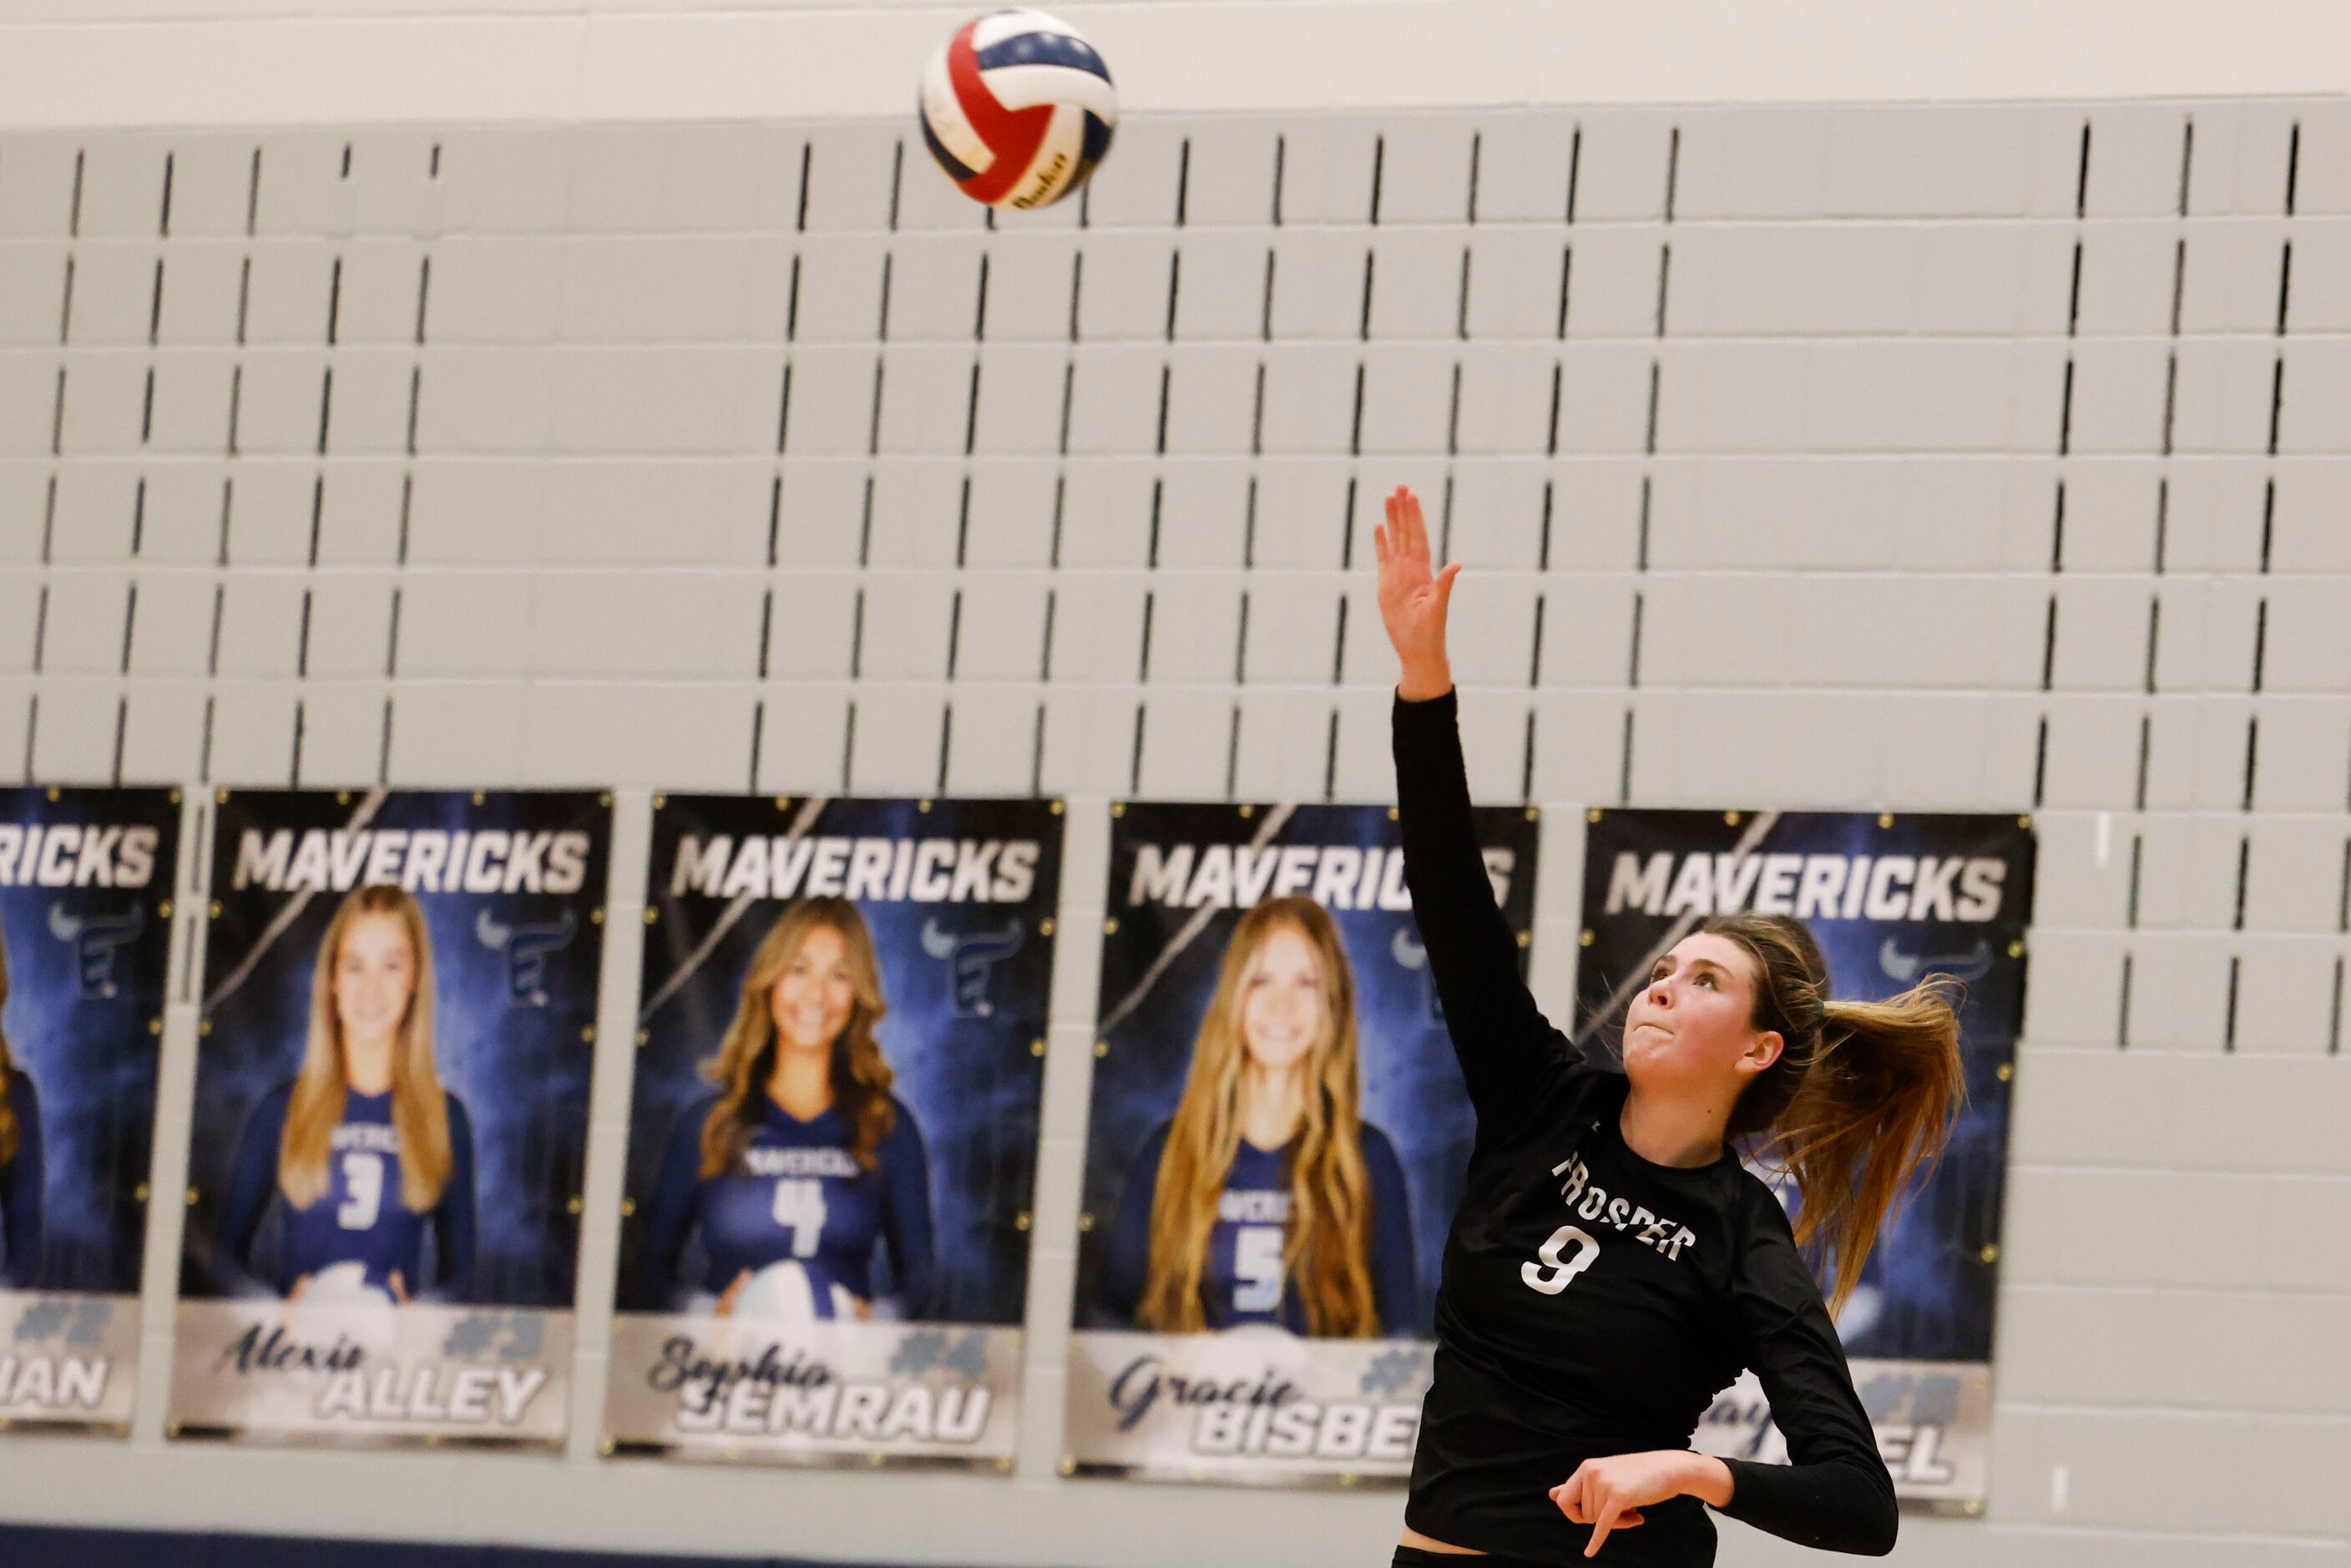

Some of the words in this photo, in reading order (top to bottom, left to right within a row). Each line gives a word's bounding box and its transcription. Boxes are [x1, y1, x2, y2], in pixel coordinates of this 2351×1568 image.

[232, 827, 589, 893] MAVERICKS
[670, 835, 1040, 903] MAVERICKS
[1129, 844, 1515, 910] MAVERICS
[1605, 850, 2006, 922] MAVERICKS
[1551, 1151, 1696, 1262] PROSPER
[1521, 1226, 1600, 1295] 9
[321, 1366, 546, 1420] ALLEY
[677, 1382, 990, 1442] SEMRAU
[1109, 1355, 1299, 1432] Gracie
[1196, 1403, 1421, 1457] BISBE
[1876, 1424, 1954, 1485] EL
